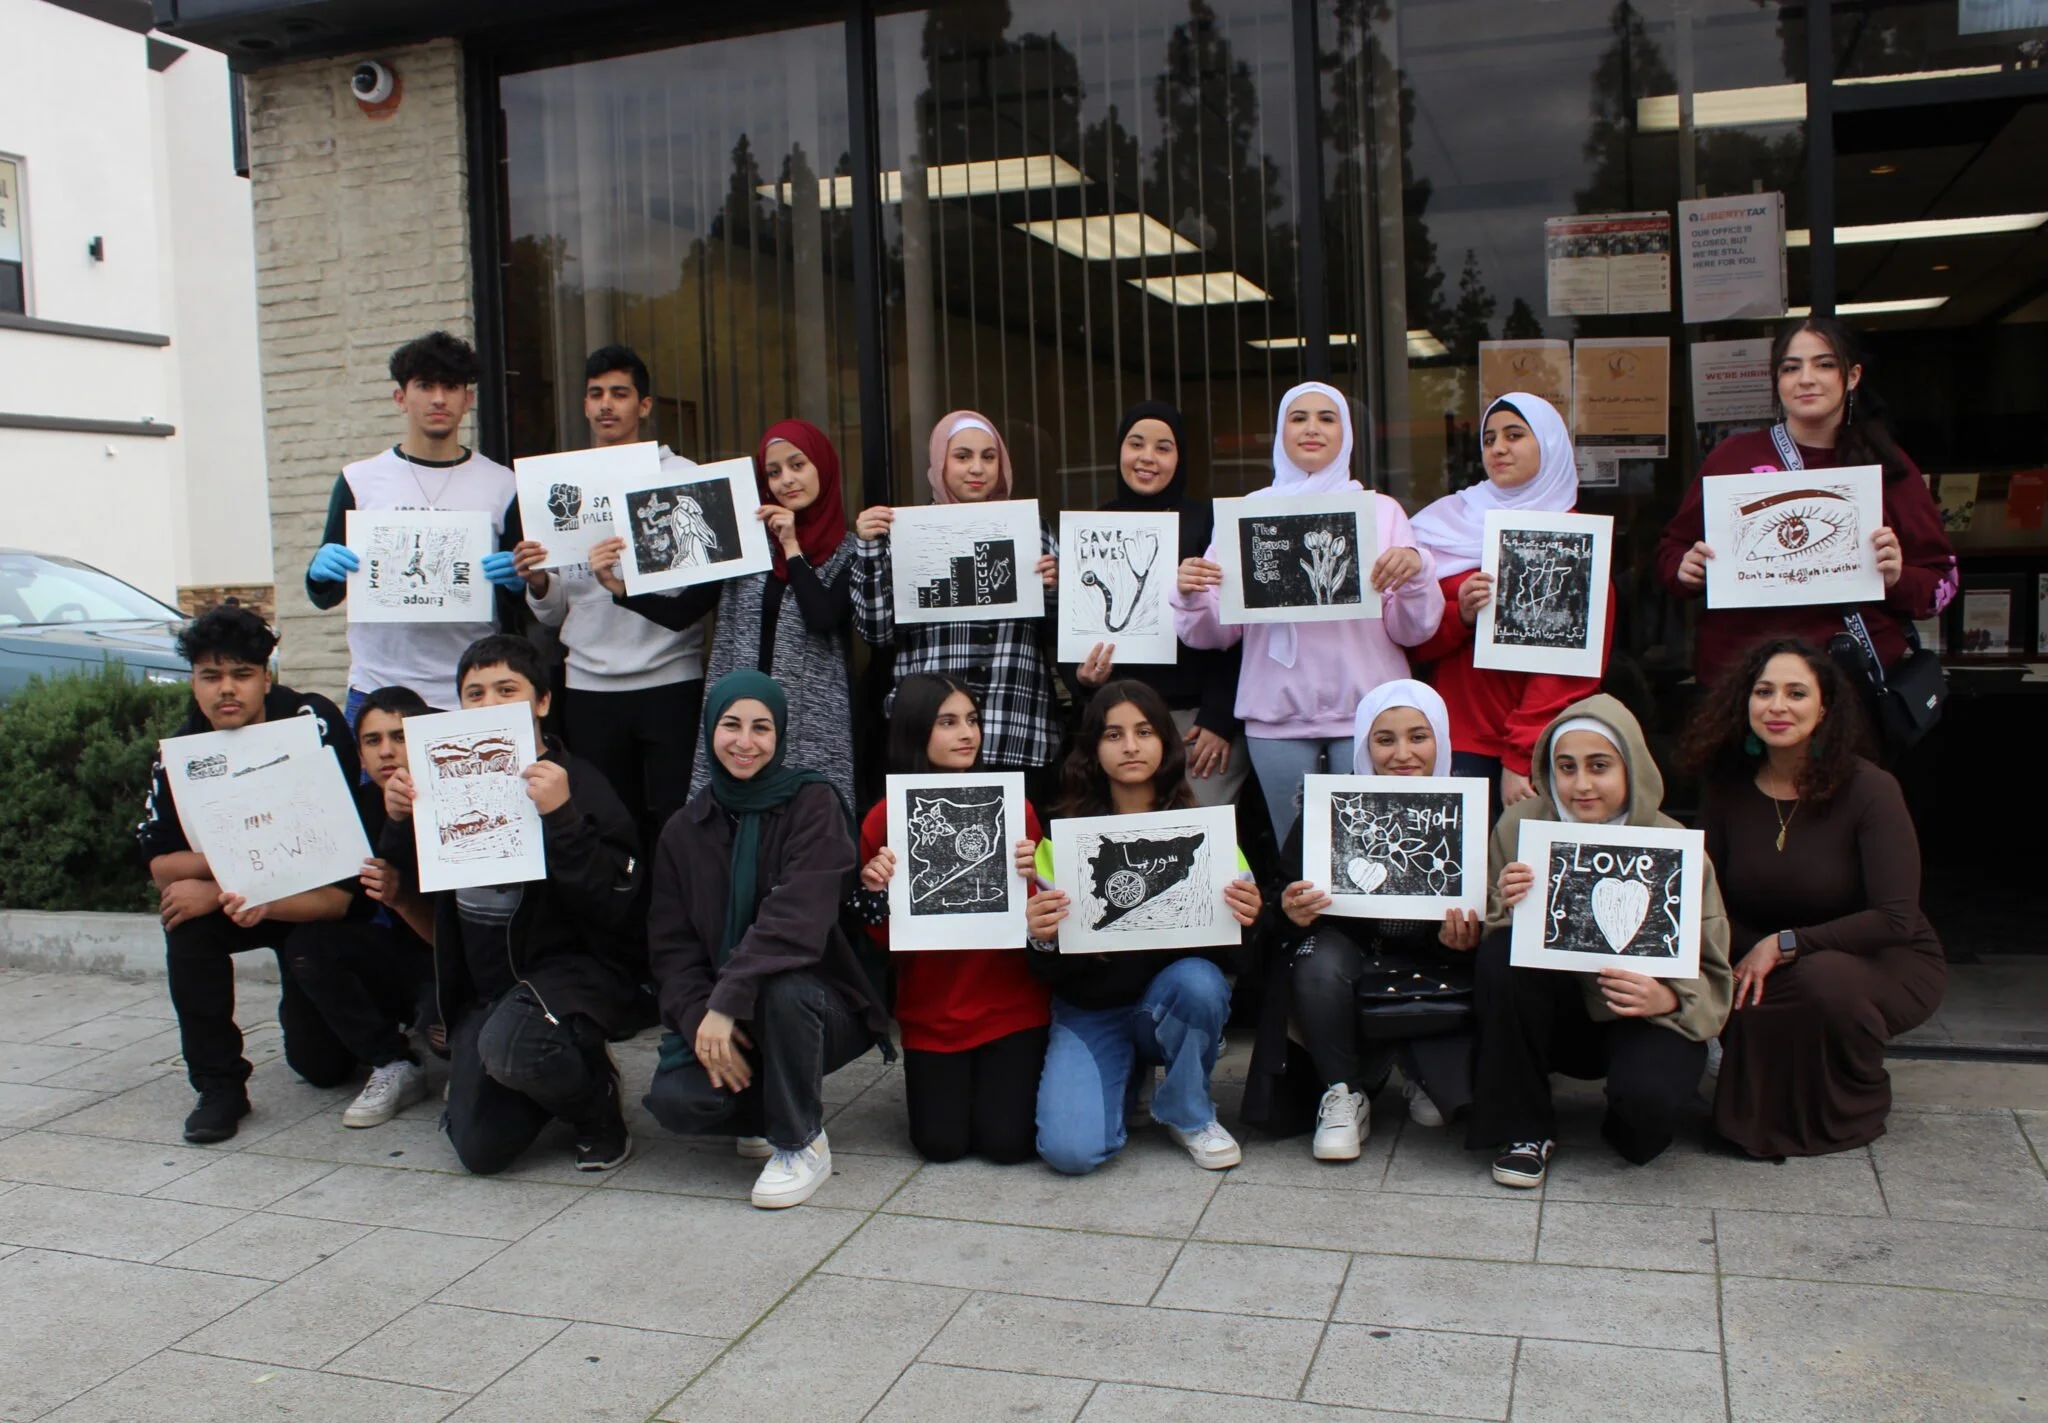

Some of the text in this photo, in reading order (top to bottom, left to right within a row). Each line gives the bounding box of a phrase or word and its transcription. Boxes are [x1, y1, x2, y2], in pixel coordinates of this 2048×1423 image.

[1691, 225, 1752, 238] OUR OFFICE IS
[1692, 236, 1748, 248] CLOSED, BUT
[1721, 248, 1745, 257] STILL
[1693, 260, 1715, 269] HERE
[1718, 259, 1736, 267] FOR
[1252, 523, 1278, 536] The
[1080, 529, 1123, 544] SAVE
[975, 542, 992, 604] SUCCESS
[1737, 570, 1762, 581] Don't
[403, 594, 444, 607] Europe
[1122, 844, 1179, 876] سوريا
